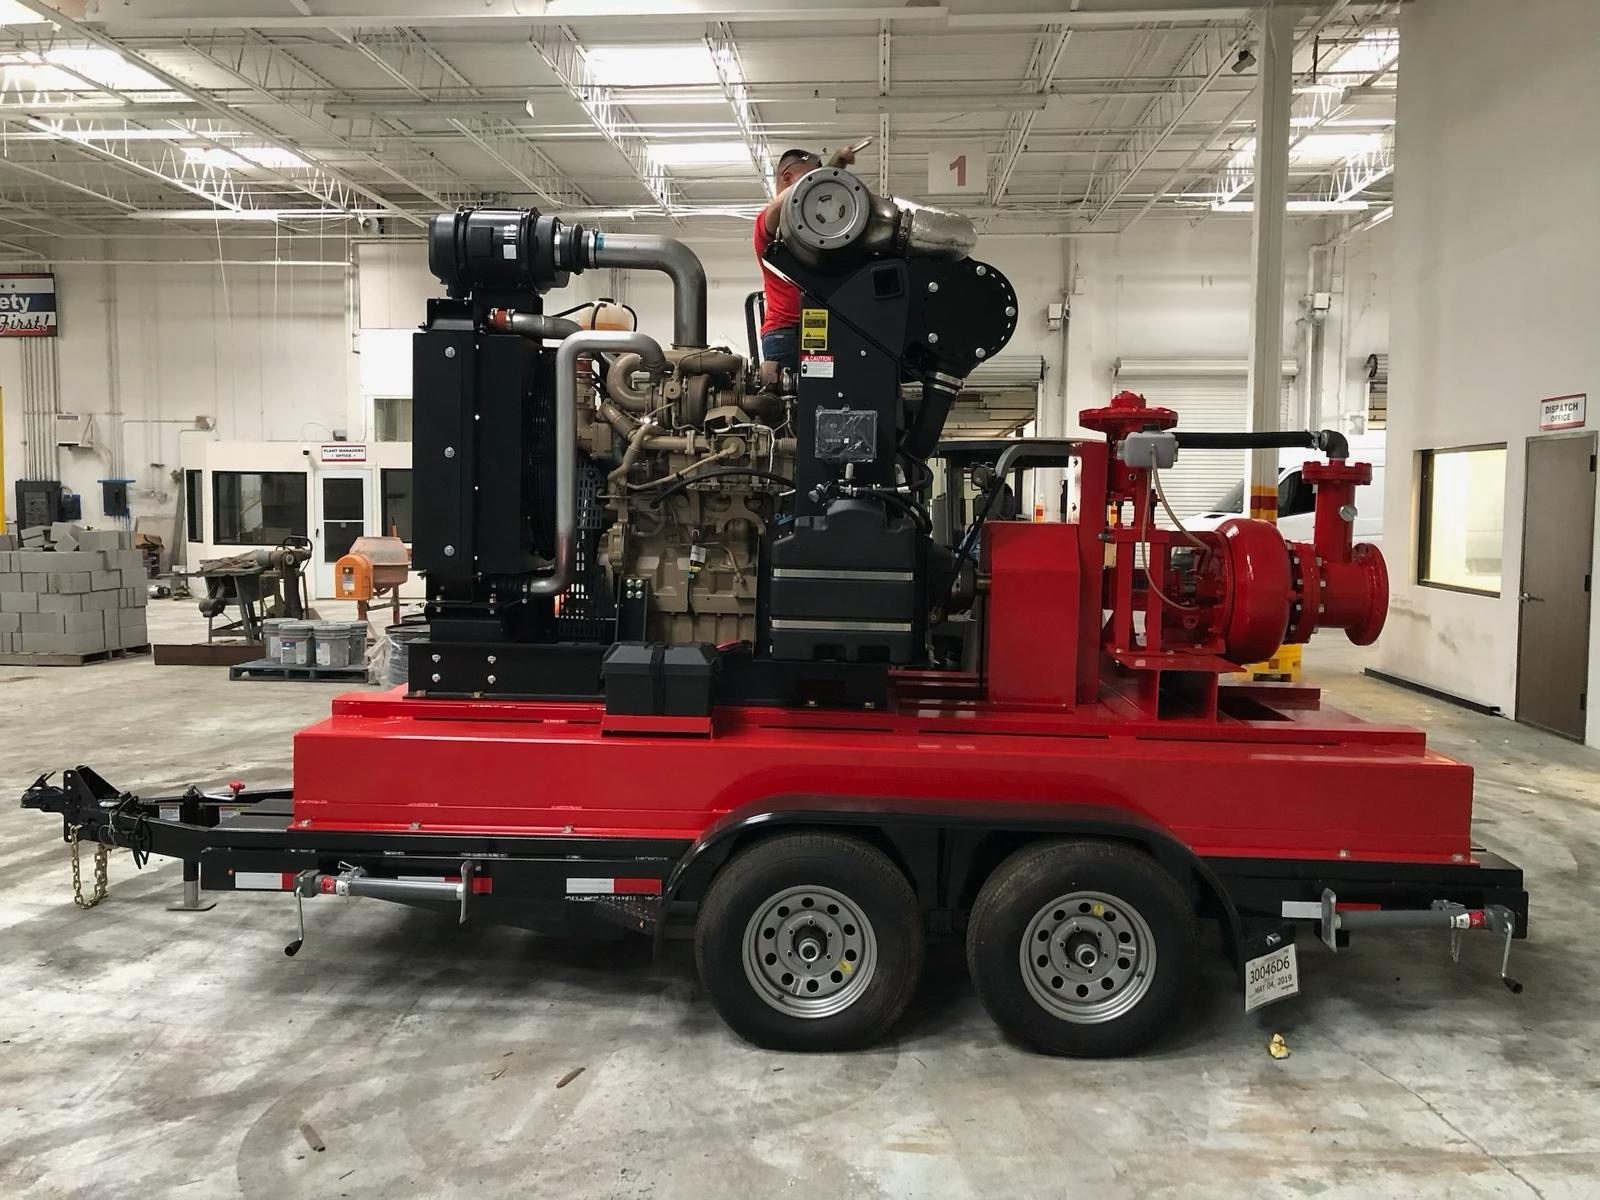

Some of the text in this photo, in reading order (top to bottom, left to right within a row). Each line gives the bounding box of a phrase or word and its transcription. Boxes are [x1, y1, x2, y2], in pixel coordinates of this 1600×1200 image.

[950, 156, 966, 186] 1
[0, 314, 49, 334] First!
[1545, 402, 1578, 414] DISPATCH
[1550, 414, 1570, 422] OFFICE
[1250, 956, 1290, 984] 30046D6
[1255, 984, 1265, 994] MAY
[1278, 974, 1292, 986] 2019
